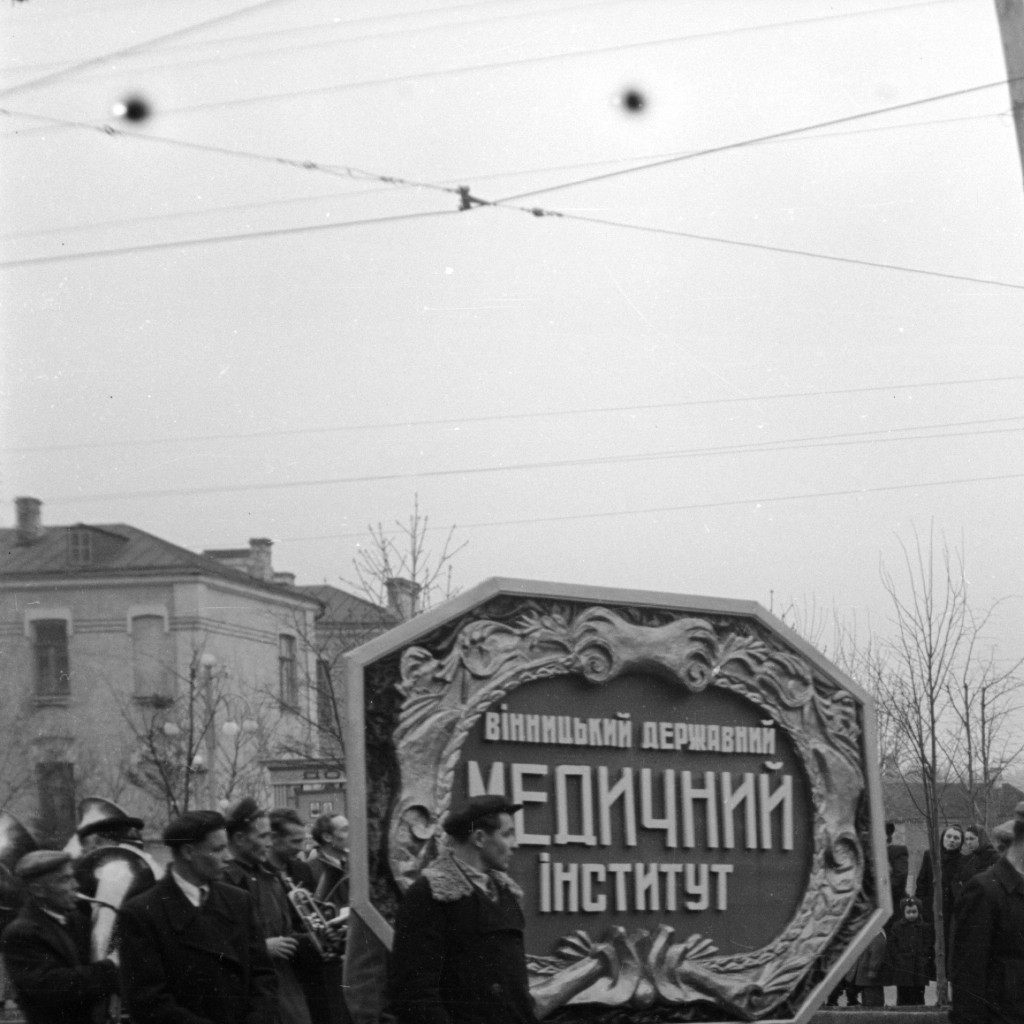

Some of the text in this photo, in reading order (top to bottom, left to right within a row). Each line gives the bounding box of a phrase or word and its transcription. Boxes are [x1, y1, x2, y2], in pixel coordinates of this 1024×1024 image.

[485, 703, 776, 755] ВІННИЦЬКИЙ ДЕРЖАВНИЙ
[540, 852, 734, 913] ІНСТИТУТ
